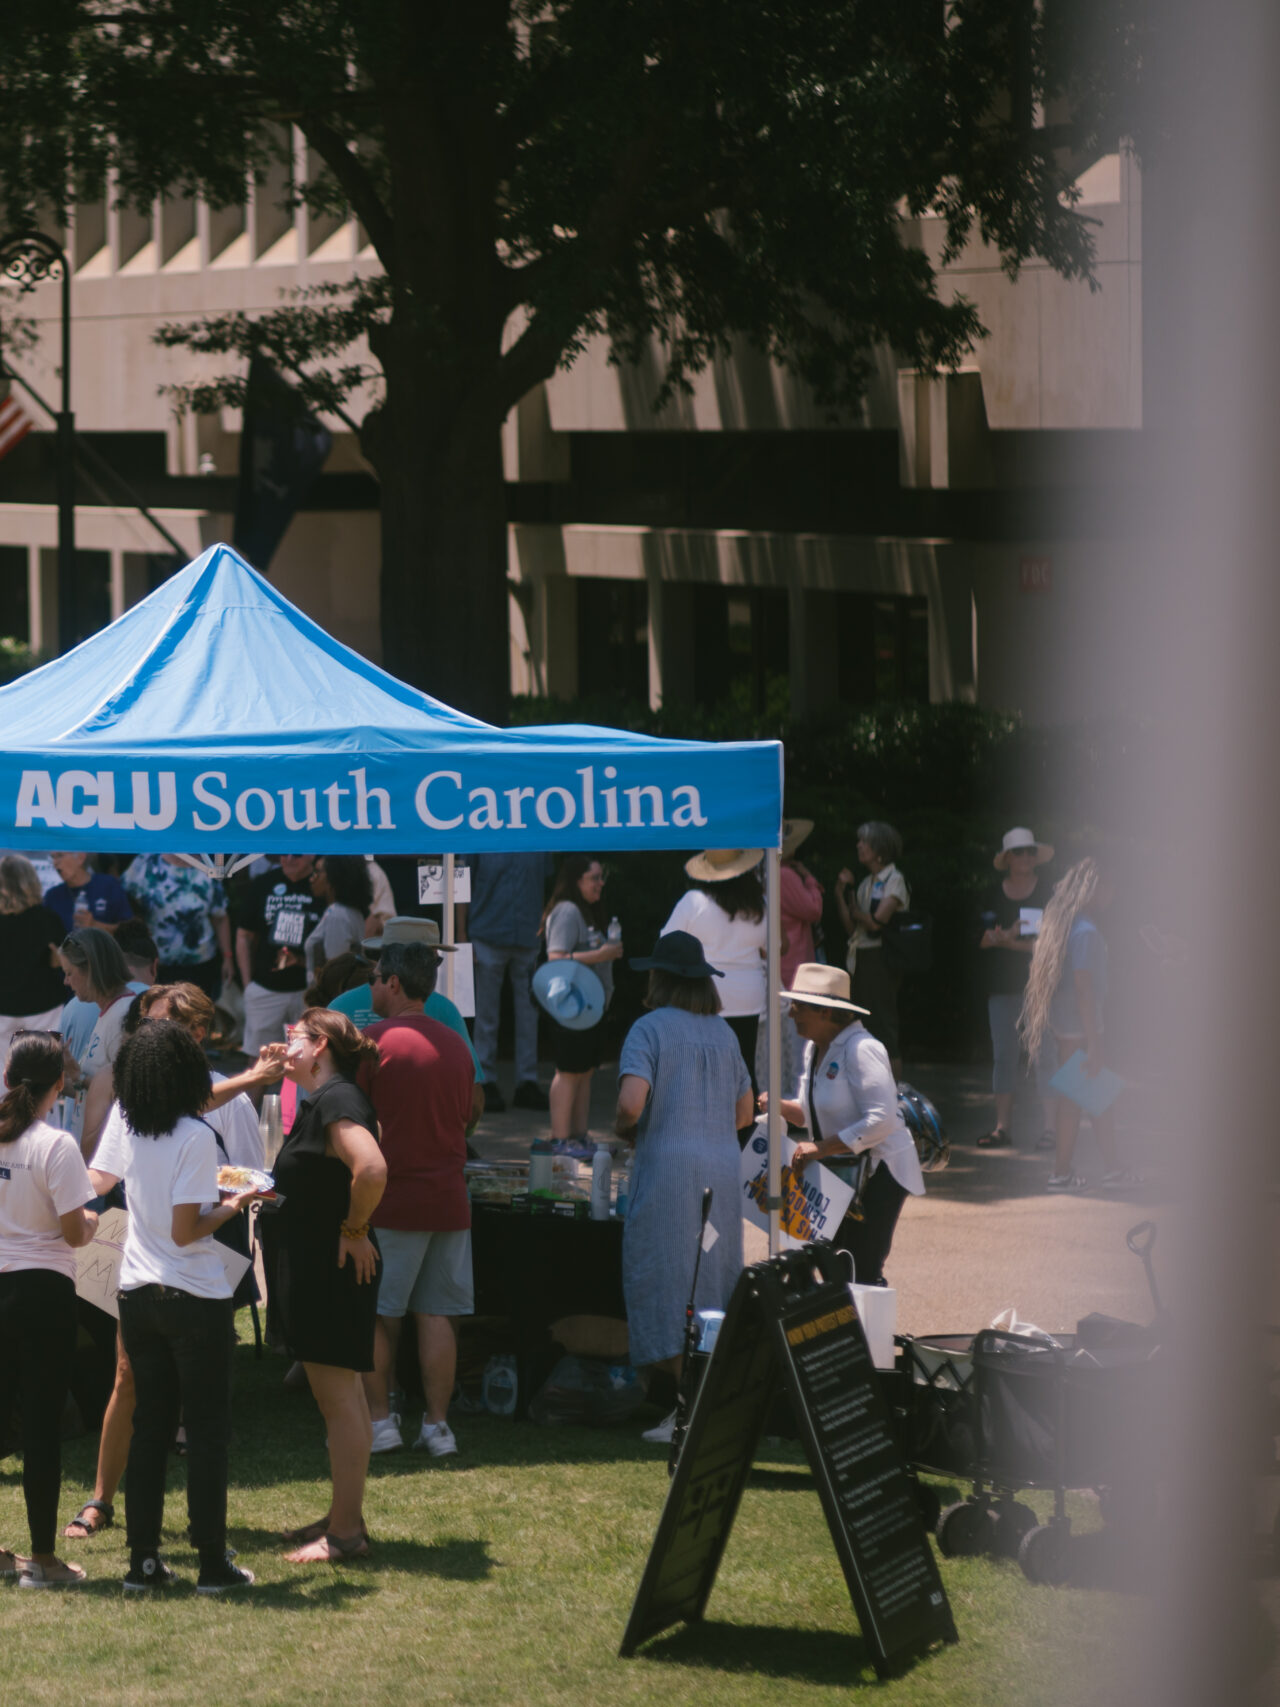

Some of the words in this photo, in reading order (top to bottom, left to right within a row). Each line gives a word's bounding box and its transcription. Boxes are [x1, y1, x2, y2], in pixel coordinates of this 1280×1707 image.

[15, 770, 177, 831] ACLU
[192, 767, 397, 832] South
[415, 766, 708, 830] Carolina
[796, 1219, 829, 1241] HIS
